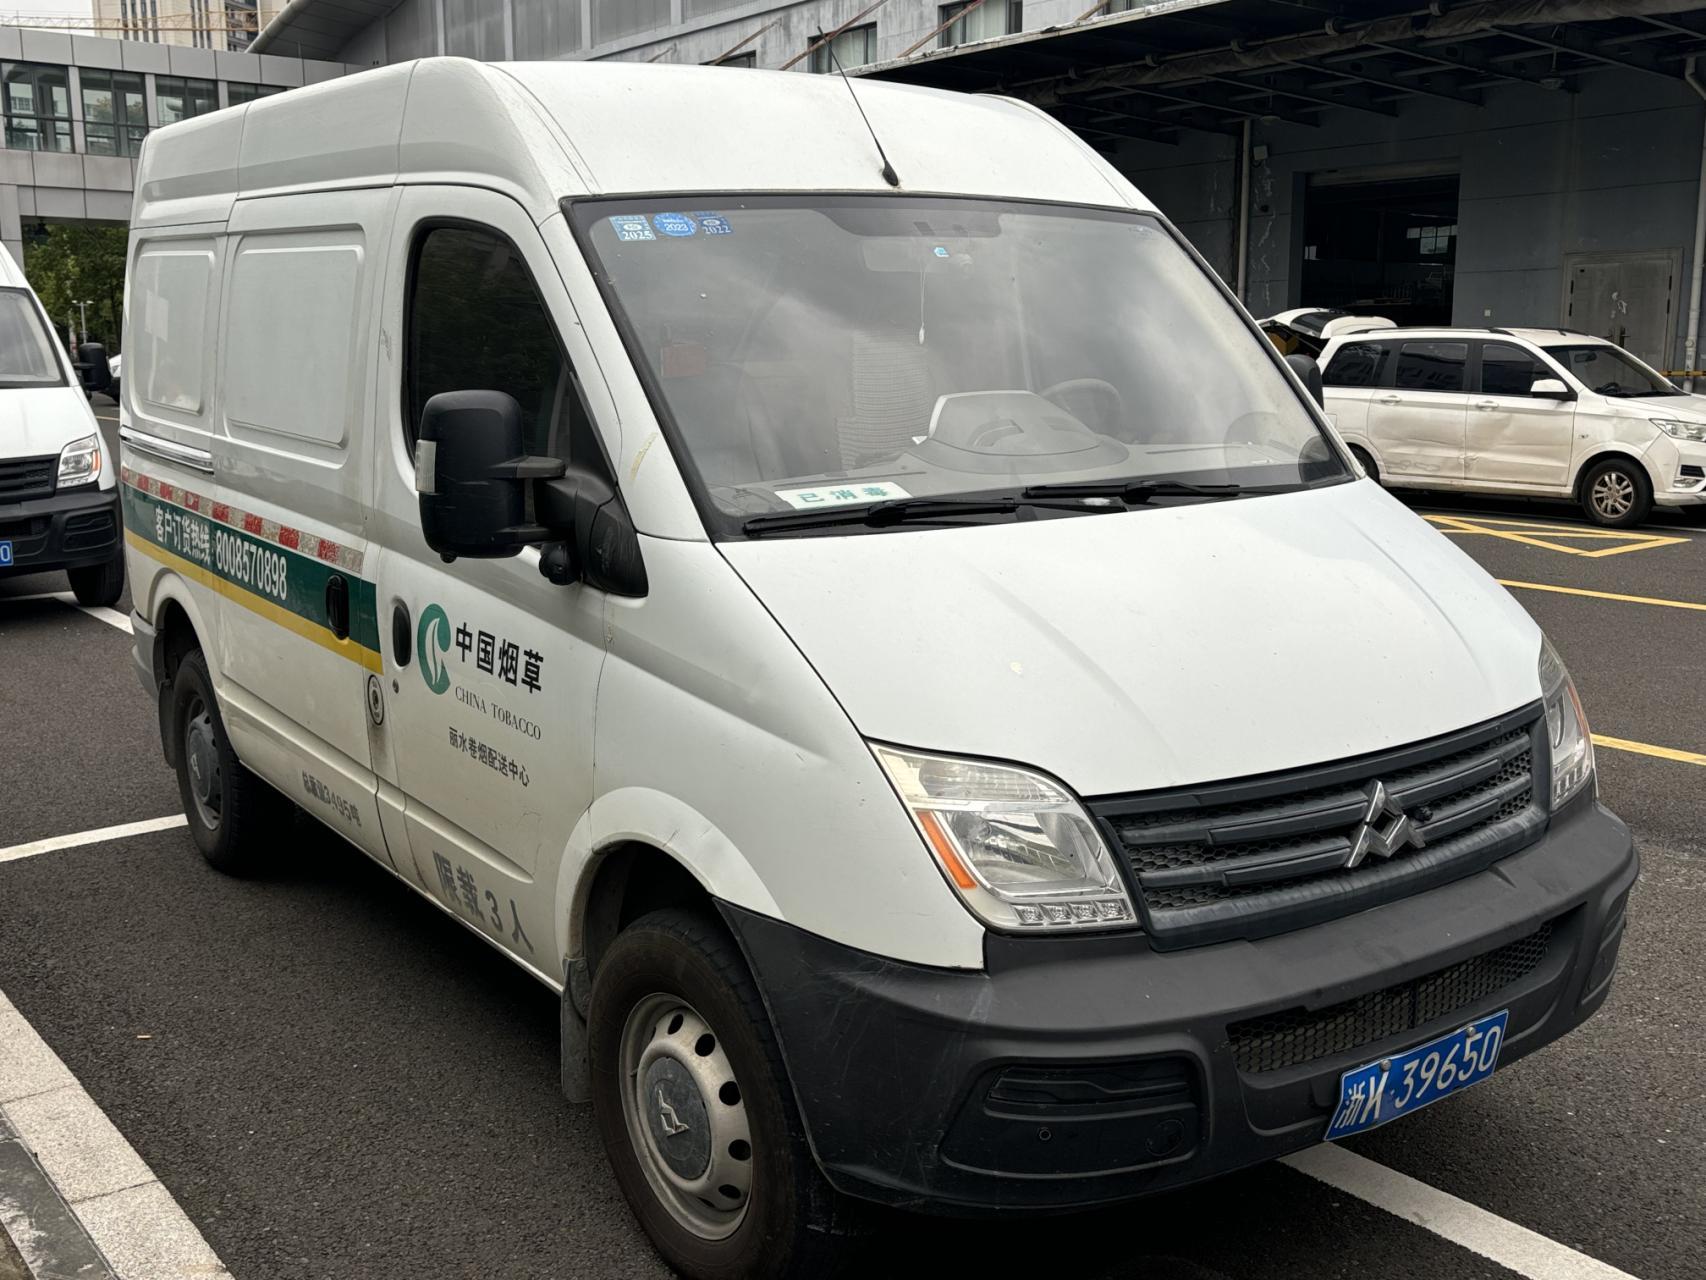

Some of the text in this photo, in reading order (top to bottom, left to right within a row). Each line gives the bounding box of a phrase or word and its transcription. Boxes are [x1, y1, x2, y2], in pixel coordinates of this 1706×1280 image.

[622, 230, 653, 240] 2025
[663, 223, 689, 231] 2023
[703, 225, 731, 234] 2022
[797, 487, 888, 503] 已消毒
[455, 622, 544, 694] 中国烟草
[455, 686, 541, 741] CHINA TOBACCO
[449, 726, 530, 787] 丽水卷烟配送中心
[432, 850, 535, 953] 限载3人
